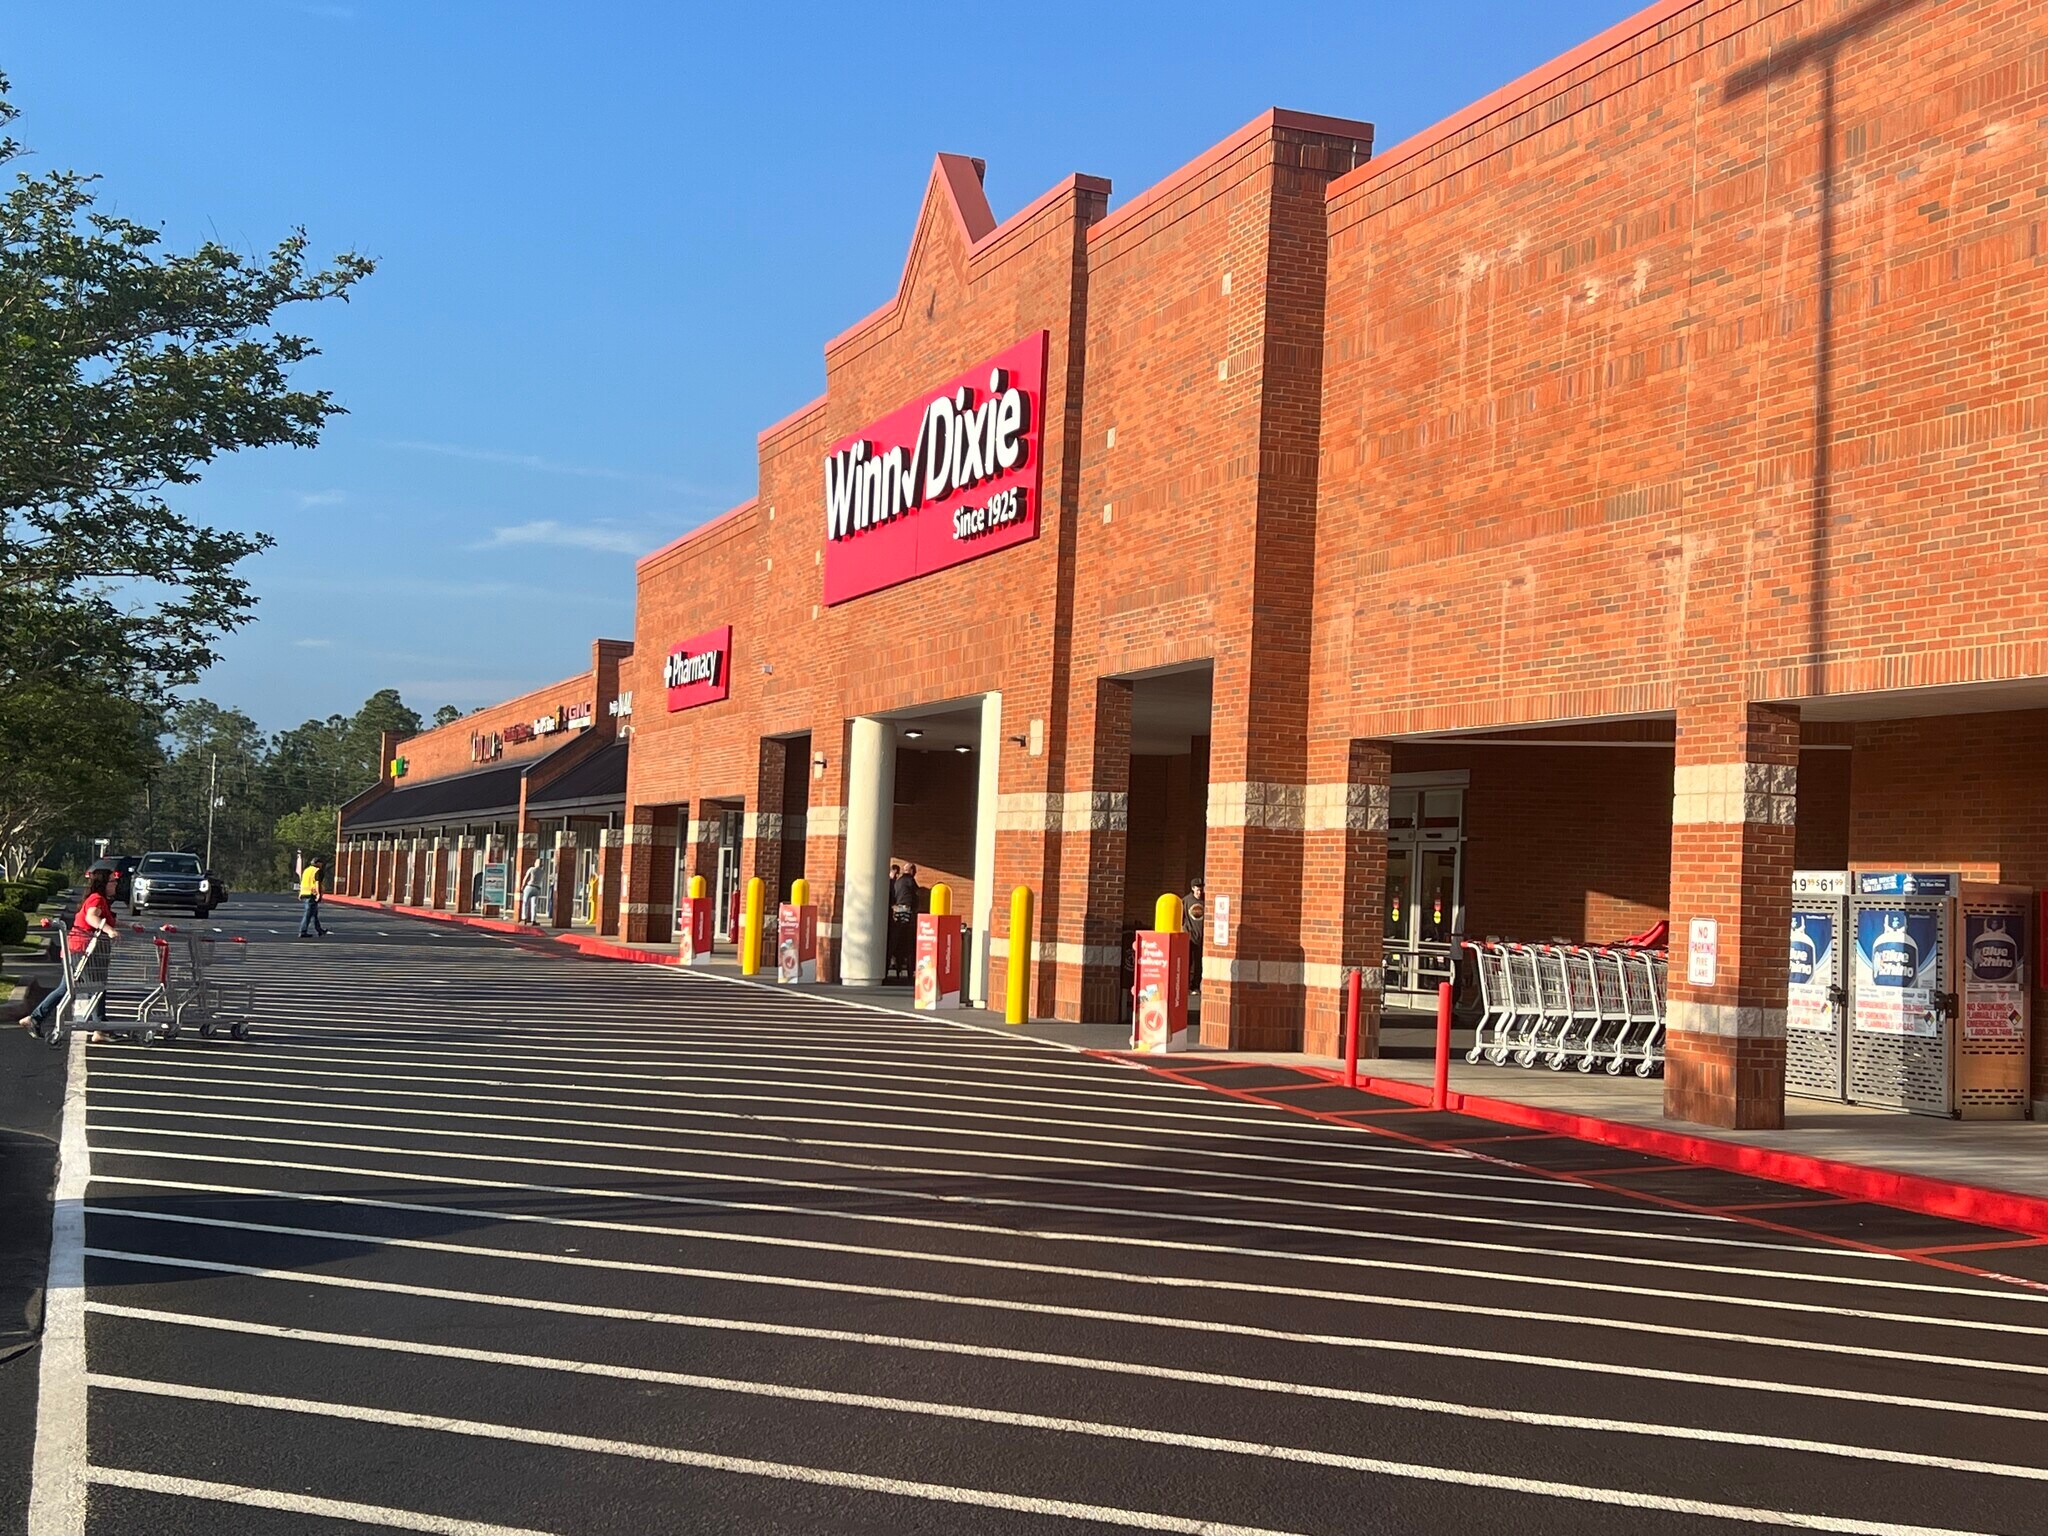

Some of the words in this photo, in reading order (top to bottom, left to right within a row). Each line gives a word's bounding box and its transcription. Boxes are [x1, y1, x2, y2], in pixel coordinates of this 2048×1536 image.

[825, 439, 903, 541] Winn
[926, 367, 1022, 501] Dixie
[953, 506, 985, 540] Since
[987, 486, 1018, 527] 1925
[672, 649, 718, 687] Pharmacy
[568, 701, 592, 720] GNC
